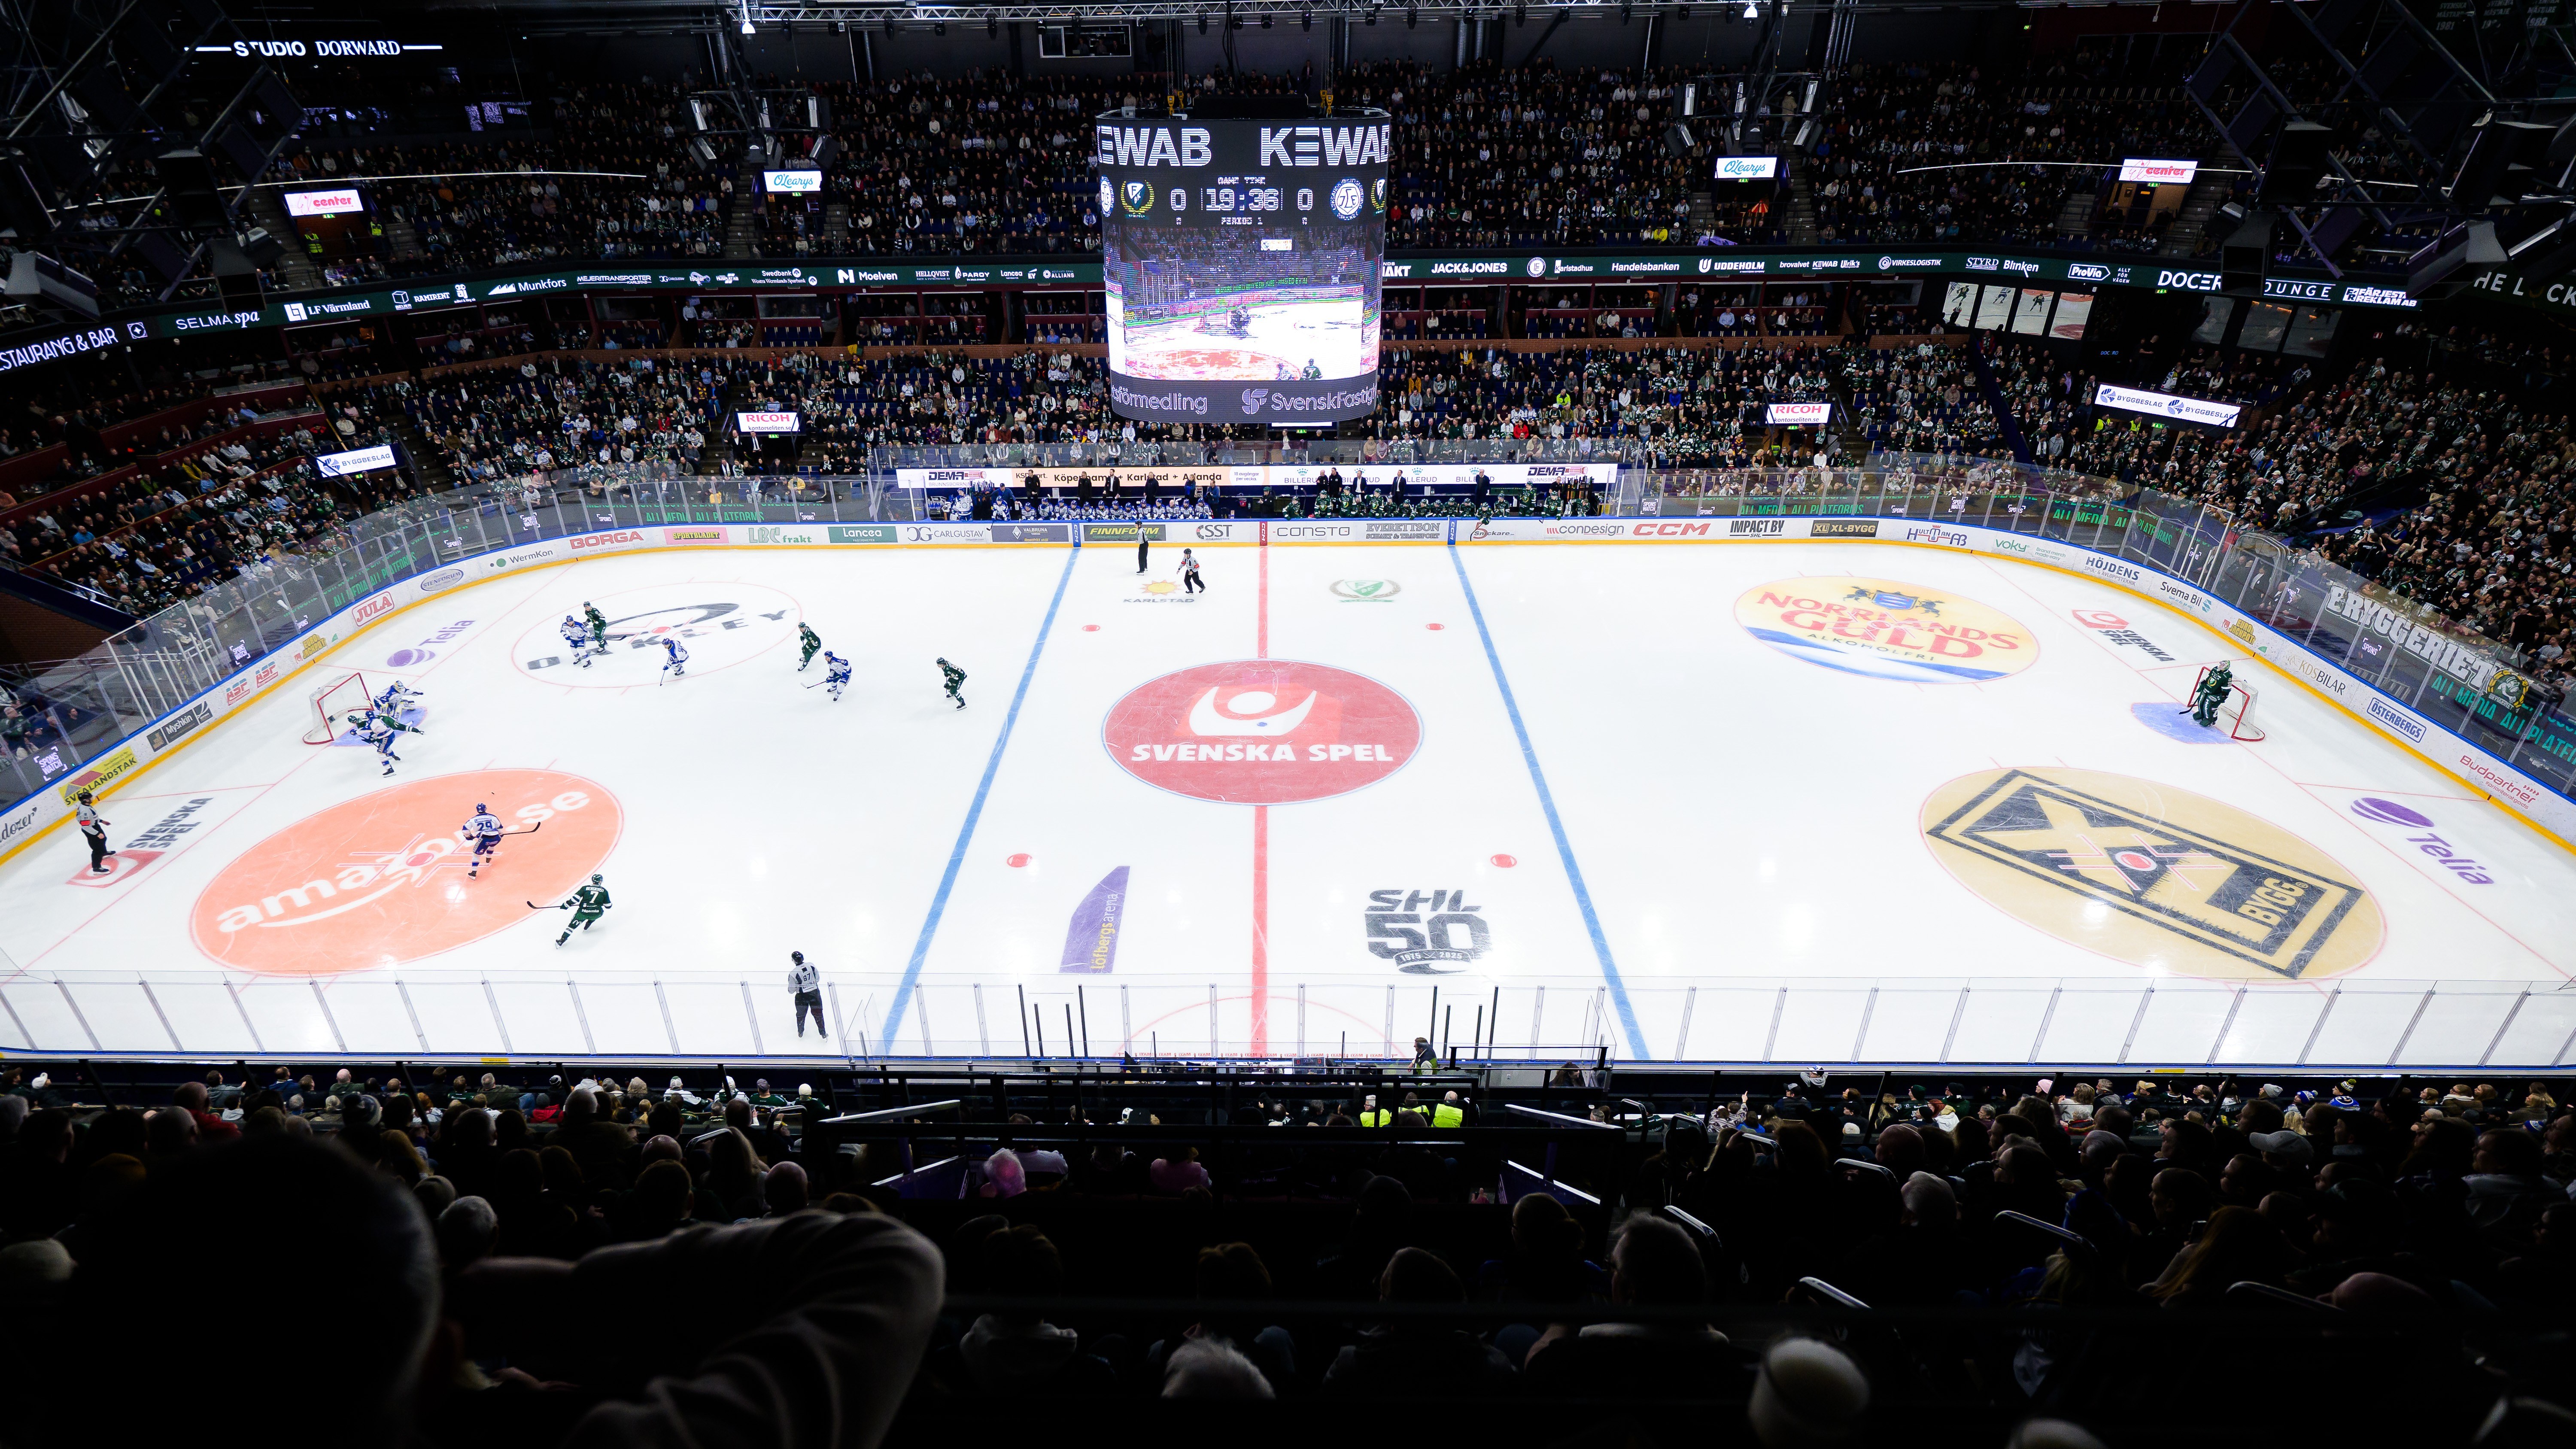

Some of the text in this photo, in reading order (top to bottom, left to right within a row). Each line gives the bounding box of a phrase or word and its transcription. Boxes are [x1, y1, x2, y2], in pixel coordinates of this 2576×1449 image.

[315, 41, 401, 56] DORWARD
[1261, 125, 1390, 167] KEWAB
[1724, 160, 1766, 176] O'Learys
[2146, 166, 2186, 176] center
[774, 174, 813, 189] O'Learys
[1218, 176, 1266, 185] GAME TIME
[313, 196, 351, 207] center
[1170, 188, 1187, 211] 0
[1206, 188, 1279, 211] 19:36
[1297, 188, 1313, 211] 0
[1221, 217, 1252, 225] PERIOD
[1431, 262, 1508, 273] JACK&JONES
[1611, 262, 1680, 271] Handelsbanken
[1714, 261, 1765, 270] UDDEHOLM
[1840, 260, 1860, 268] Ulrik's
[1965, 257, 2039, 278] STYRD Blinken
[859, 271, 898, 281] Moelven
[2071, 266, 2102, 278] ProVia
[517, 278, 567, 292] Munkfors
[413, 292, 450, 302] RAMIRENT
[2354, 295, 2402, 306] REKLAM
[308, 299, 371, 316] LF Värmland
[175, 311, 260, 330] SELMA spa
[76, 327, 119, 351] & BAR
[2117, 395, 2163, 407] BYGGBESLAG
[1775, 405, 1822, 413] RICOH
[2185, 407, 2235, 419] BYGGBESLAG
[342, 453, 391, 466] BYGGBESLAG
[928, 471, 965, 480] DEMA
[1127, 473, 1169, 481] Karltad
[1528, 467, 1566, 476] DEMA
[843, 527, 882, 538] Lancea
[1366, 523, 1440, 532] EVERETTSON
[1633, 523, 1711, 536] CCM
[1730, 520, 1785, 533] IMPACT BY
[1830, 525, 1876, 533] XL-BYGG
[569, 531, 644, 550] BORGA
[672, 531, 720, 540] SPORTBLADET
[783, 535, 812, 543] frakt
[1950, 533, 1968, 546] AB
[510, 549, 553, 564] WermKon
[2084, 565, 2097, 574] SPOL-
[2101, 570, 2136, 587] AVLOPPSTEKNIK
[2086, 556, 2140, 581] HÖJDENS
[422, 571, 462, 589] STENFORUM
[2160, 581, 2190, 601] Svema
[2190, 593, 2203, 607] Bil
[356, 595, 392, 623] JULA
[1756, 591, 2020, 650] NORRLANDS
[2237, 618, 2253, 632] EURO
[419, 620, 476, 646] Telia
[1780, 610, 1984, 658] GULD
[2098, 629, 2132, 646] SPEL
[2228, 625, 2256, 645] JACKPOT
[2325, 585, 2493, 689] BRYGGERIET
[1807, 633, 1935, 661] ALKOHOLFRI
[2116, 629, 2176, 662] SVENSKA
[2362, 642, 2379, 656] SPONS
[166, 714, 194, 735] Myshkin
[2371, 700, 2423, 738] ÖSTERBERGS
[38, 752, 60, 769] SPONS
[1130, 744, 1394, 762] SVENSKA SPEL
[42, 759, 64, 775] WATCH
[2460, 755, 2537, 804] Budpartner
[126, 796, 215, 849] SVENSKA
[477, 821, 492, 831] 29
[148, 821, 200, 851] SPEL
[2406, 832, 2495, 885] Telia
[590, 890, 599, 904] 7
[1364, 889, 1483, 913] SHL
[2237, 876, 2300, 927] BYGG
[1364, 913, 1493, 962] 50
[1399, 951, 1464, 963] 1975 2025
[803, 972, 811, 982] 67
